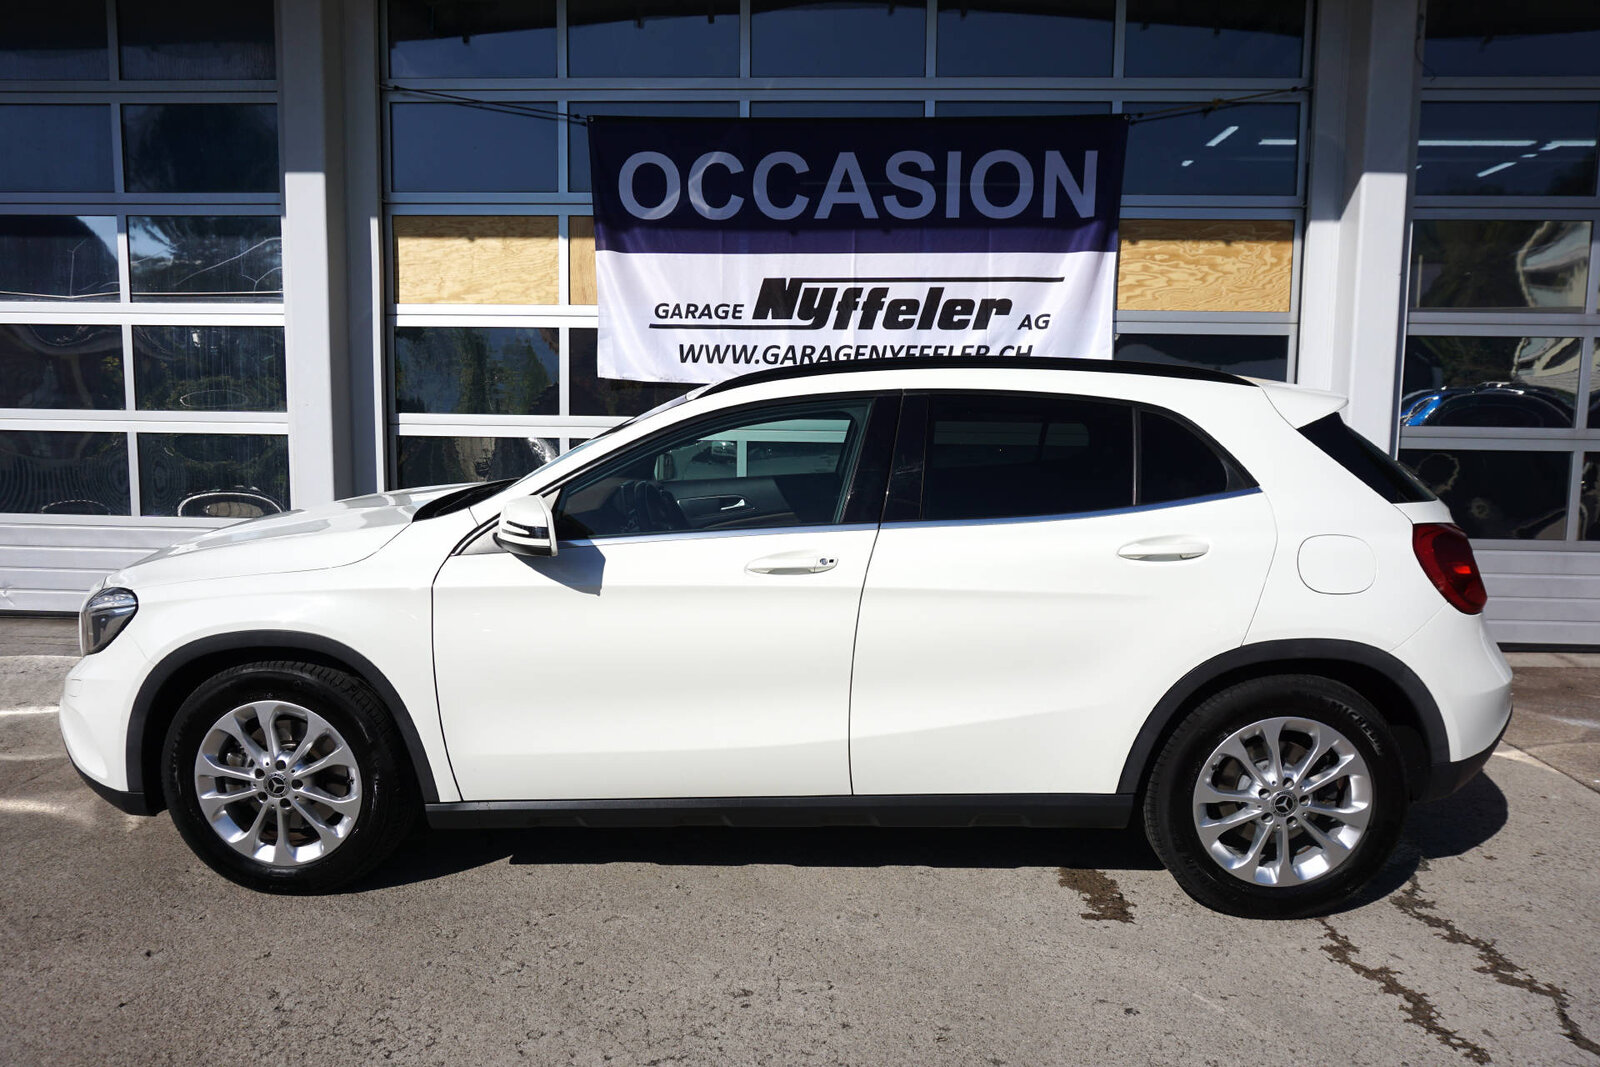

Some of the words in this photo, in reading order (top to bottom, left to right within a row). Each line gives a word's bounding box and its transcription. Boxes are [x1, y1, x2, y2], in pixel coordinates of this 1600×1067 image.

[618, 150, 1099, 221] OCCASION
[654, 303, 744, 320] GARAGE
[751, 277, 1013, 331] Nyffeler
[1017, 313, 1051, 331] AG
